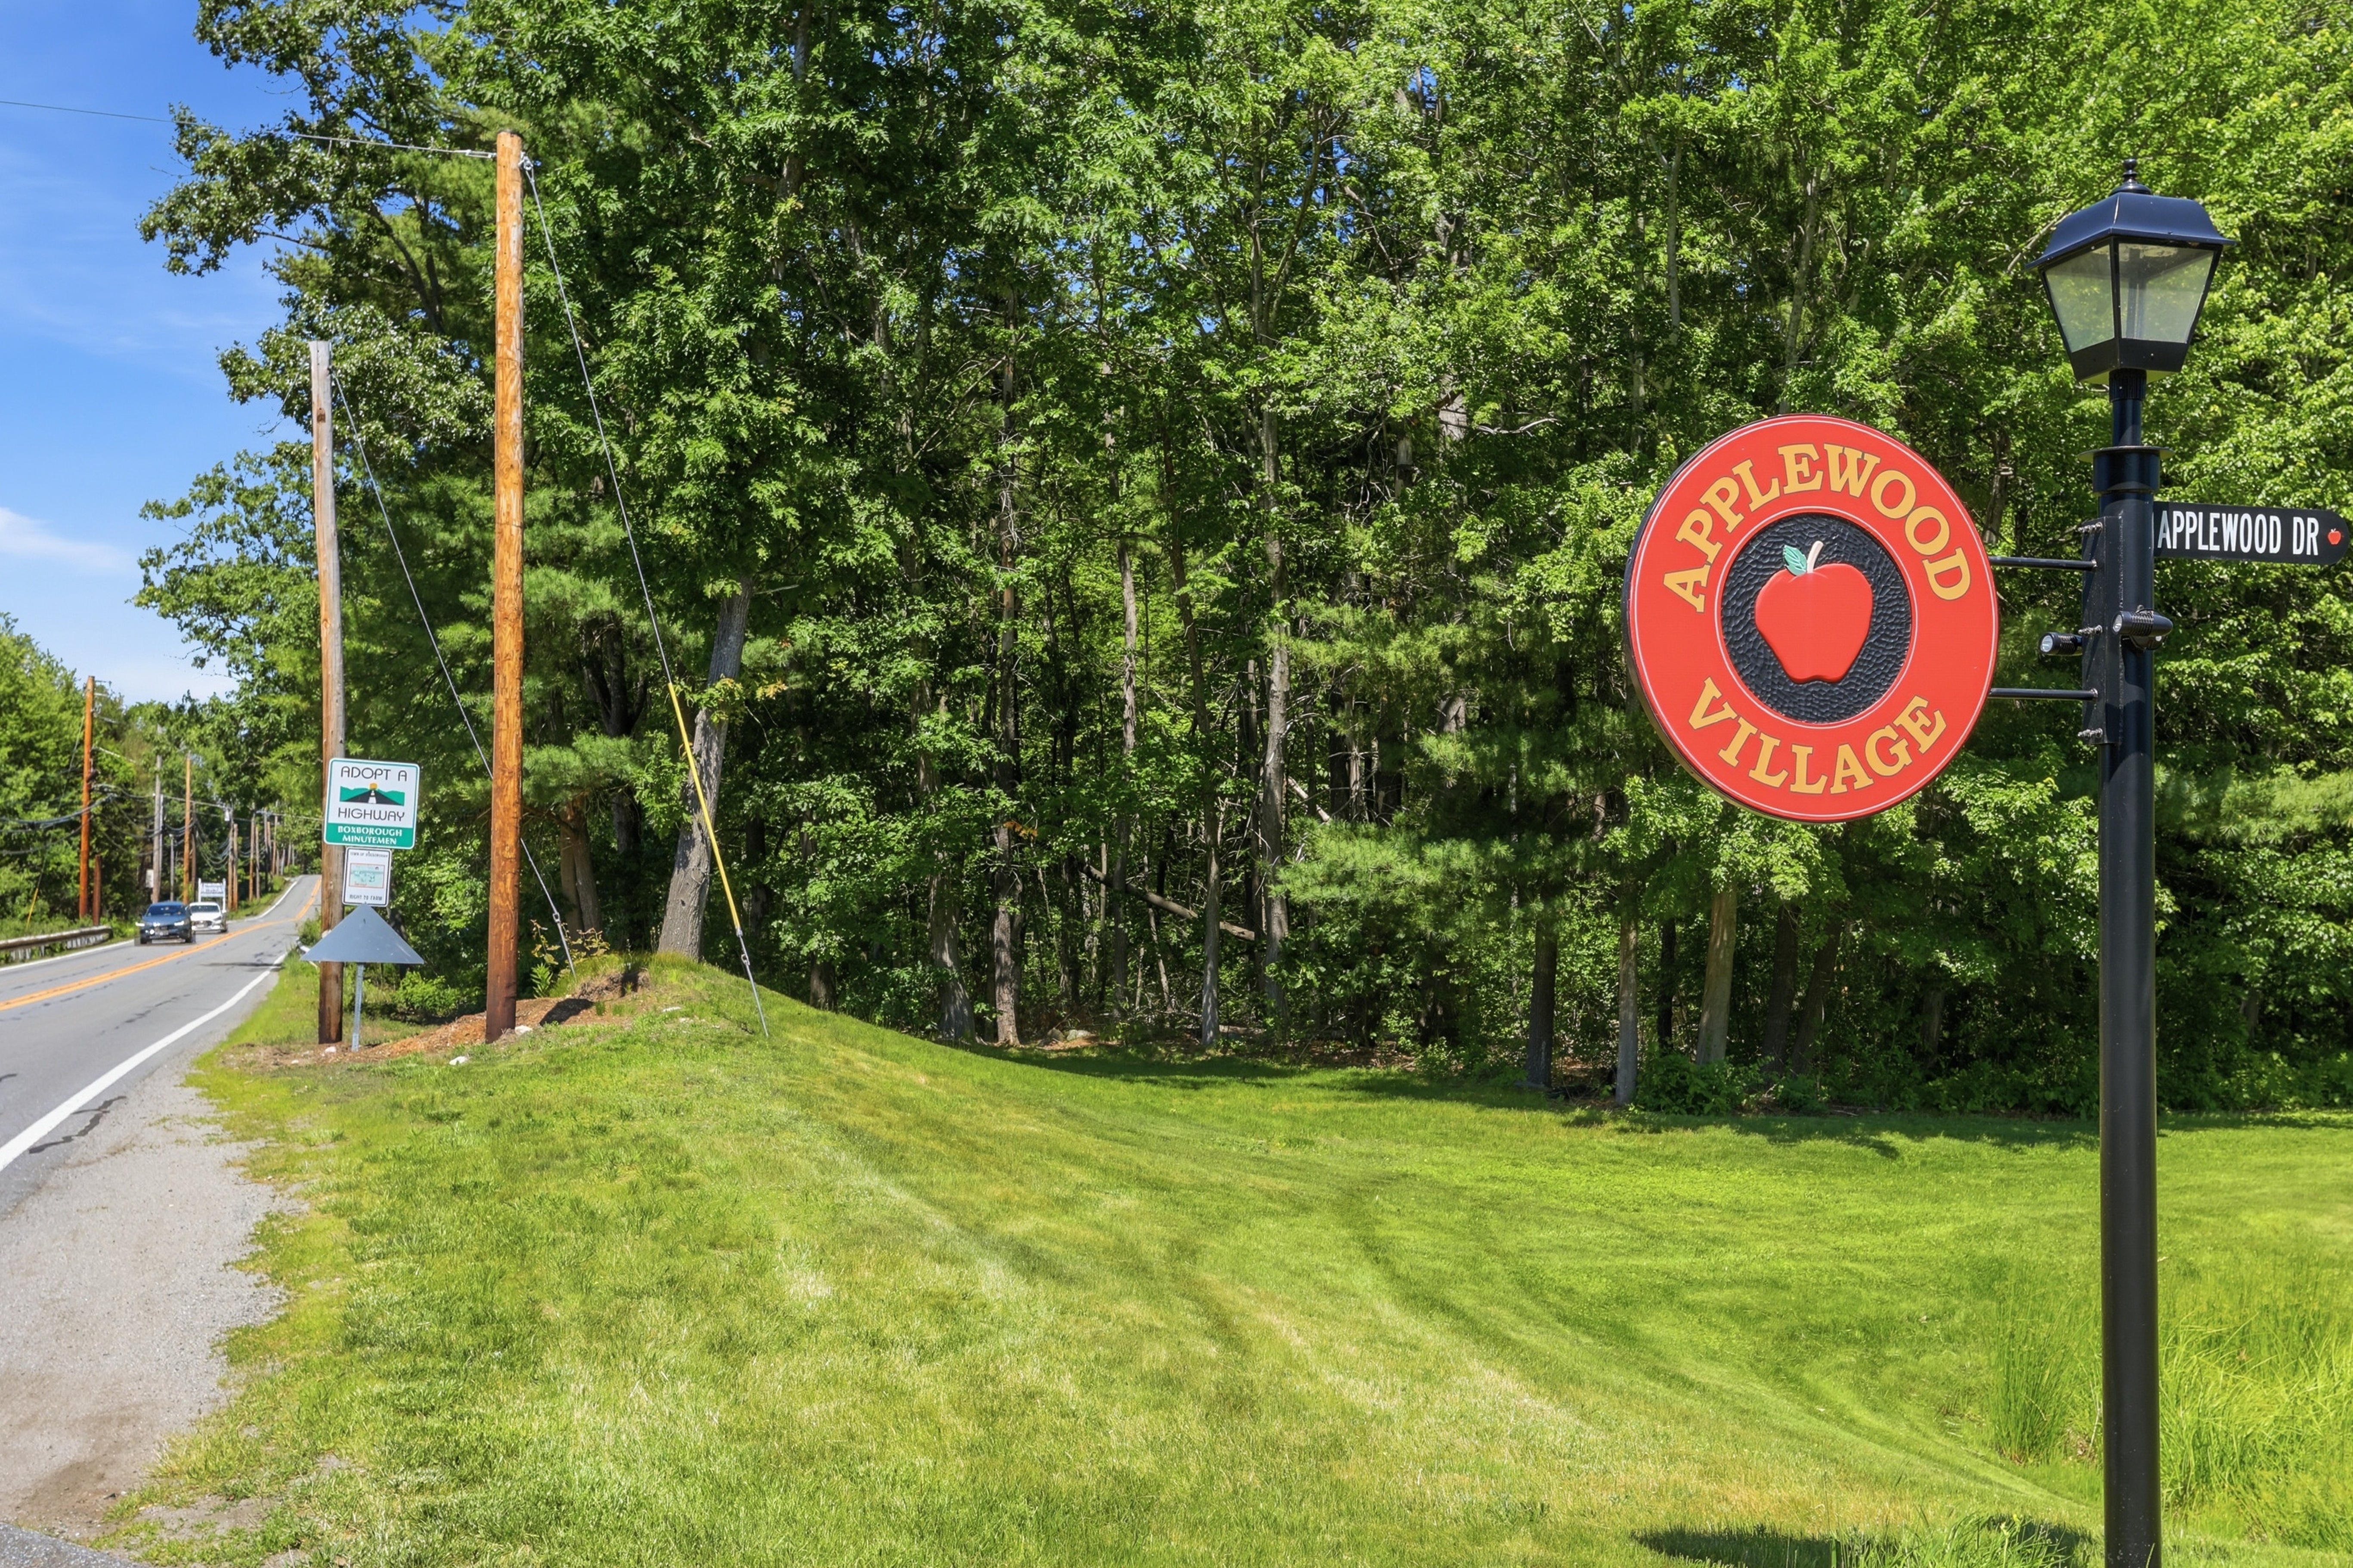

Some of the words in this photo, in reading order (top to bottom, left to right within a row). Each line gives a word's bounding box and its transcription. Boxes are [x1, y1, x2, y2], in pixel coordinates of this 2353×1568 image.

[1663, 443, 1971, 612] APPLEWOOD
[2157, 510, 2281, 554] APPLEWOOD
[2293, 516, 2319, 555] DR
[1688, 677, 1946, 795] VILLAGE
[340, 766, 391, 780] ADOPT
[398, 770, 407, 781] A
[338, 807, 405, 821] HIGHWAY
[338, 826, 402, 837] BOXBOROUGH
[342, 835, 397, 845] MINUTEMEN
